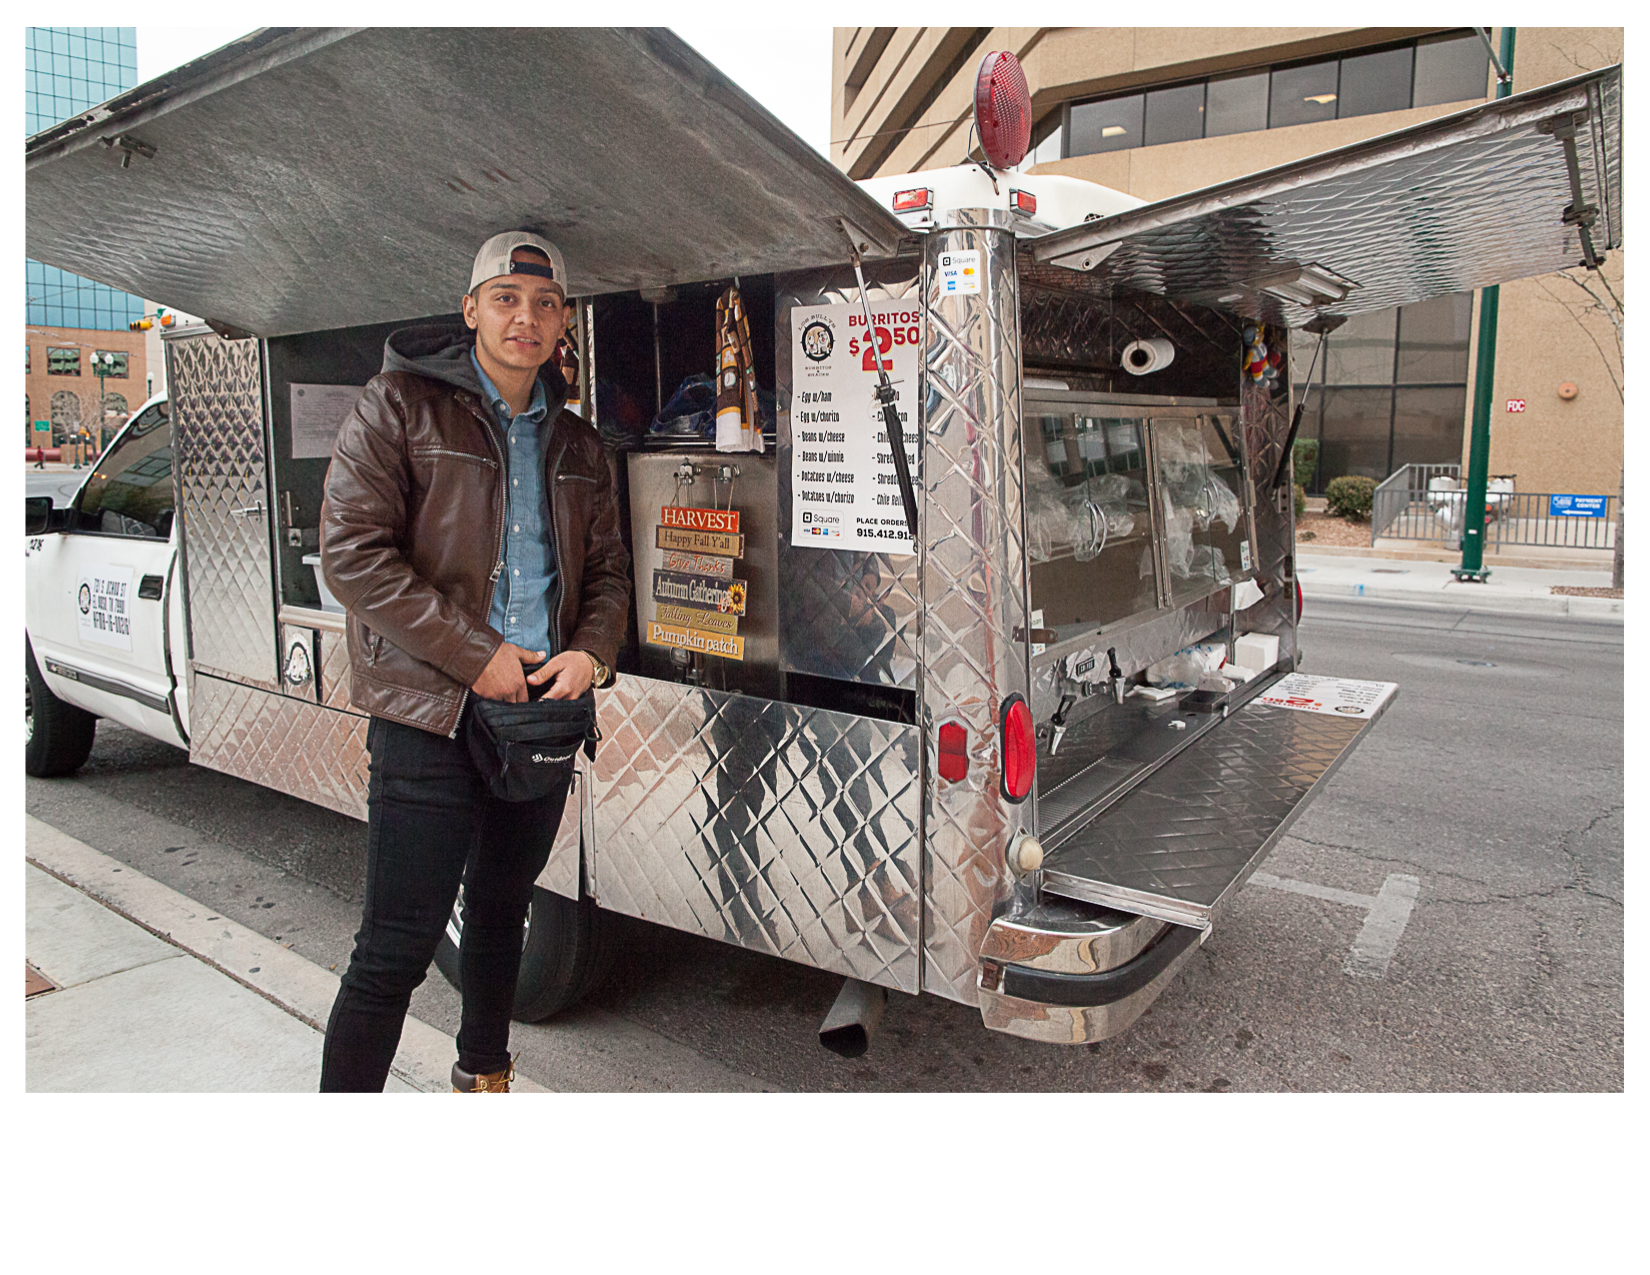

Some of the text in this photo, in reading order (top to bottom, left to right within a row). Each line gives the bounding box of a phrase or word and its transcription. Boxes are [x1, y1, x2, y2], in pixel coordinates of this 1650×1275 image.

[848, 311, 919, 326] BURRITOS
[802, 390, 832, 404] Egg w/ham
[1507, 400, 1525, 412] FDC
[800, 410, 840, 423] Egg w/chorizo
[802, 430, 845, 443] Beans w/cheese
[802, 450, 818, 462] Beans
[802, 470, 854, 483] Potatoes w/cheese
[802, 490, 854, 504] Potatoes w/chorizo
[876, 493, 890, 506] Chile
[664, 508, 735, 530] HARVEST
[813, 514, 840, 524] Square
[664, 530, 730, 549] Happy Fall Y'all
[669, 552, 725, 574] Give Thanks
[656, 576, 732, 612] Autumn Gatherings
[92, 594, 98, 609] EL
[660, 606, 734, 630] Falling Leaves
[652, 624, 738, 656] Pumpkin patch
